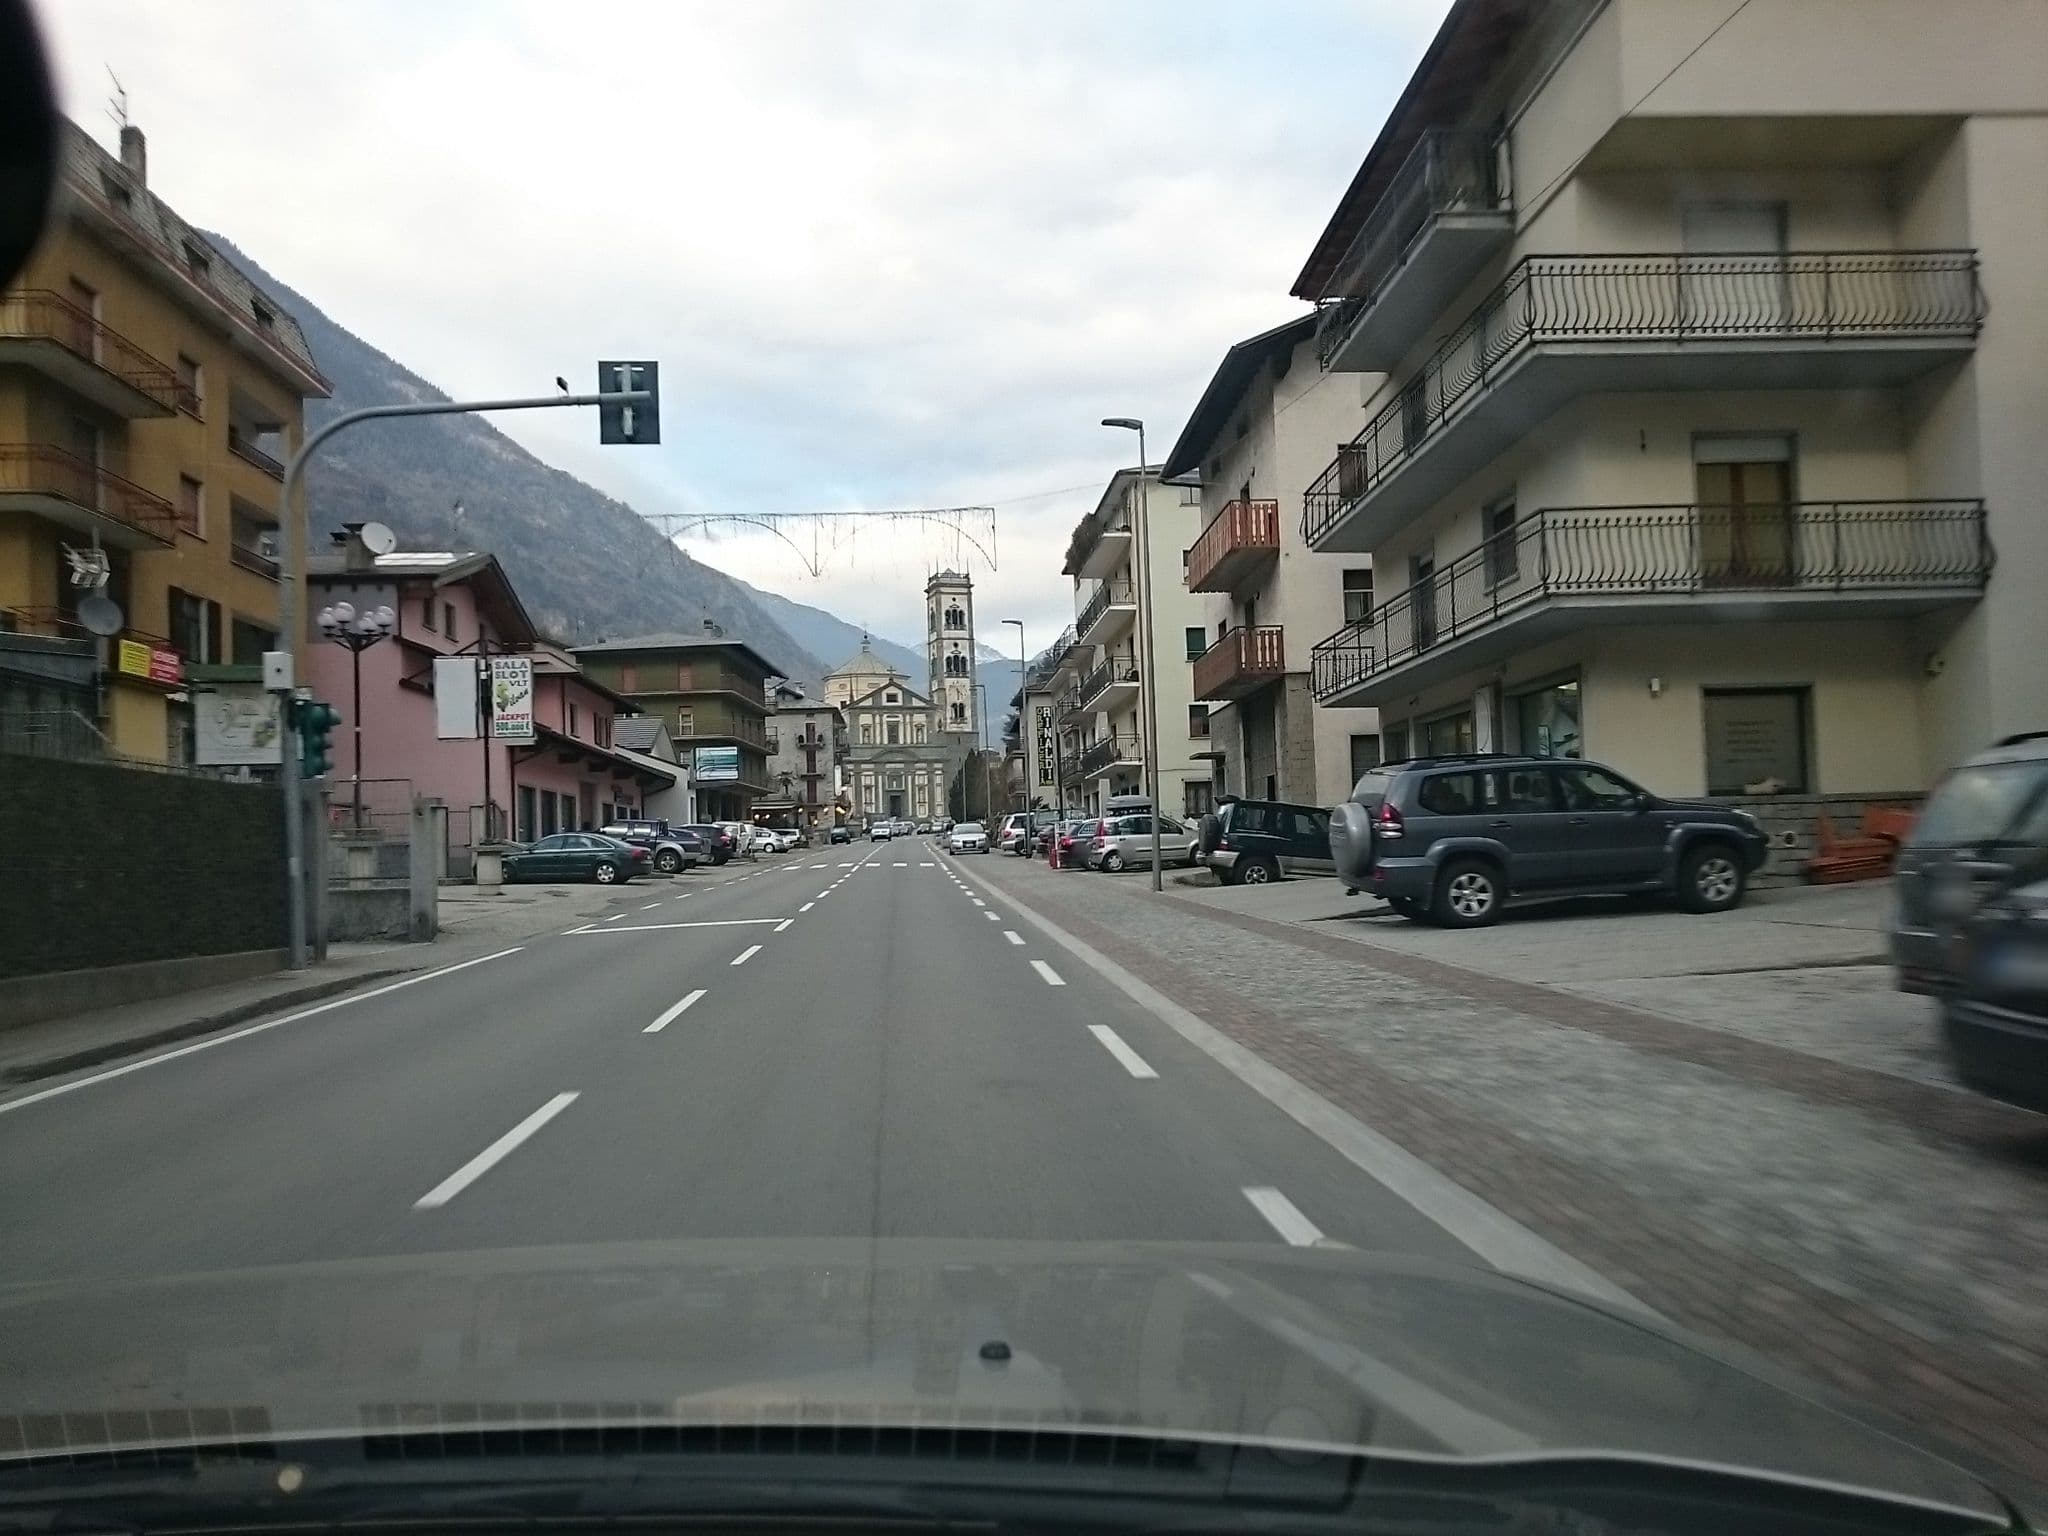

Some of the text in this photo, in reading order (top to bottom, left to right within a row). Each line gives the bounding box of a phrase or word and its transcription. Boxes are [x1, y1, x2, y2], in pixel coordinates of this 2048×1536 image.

[495, 661, 528, 669] SALA
[495, 670, 528, 679] SLOT
[496, 713, 530, 721] JACKPOT
[1037, 708, 1045, 785] OREFICERIA
[1043, 707, 1053, 780] RINALDI
